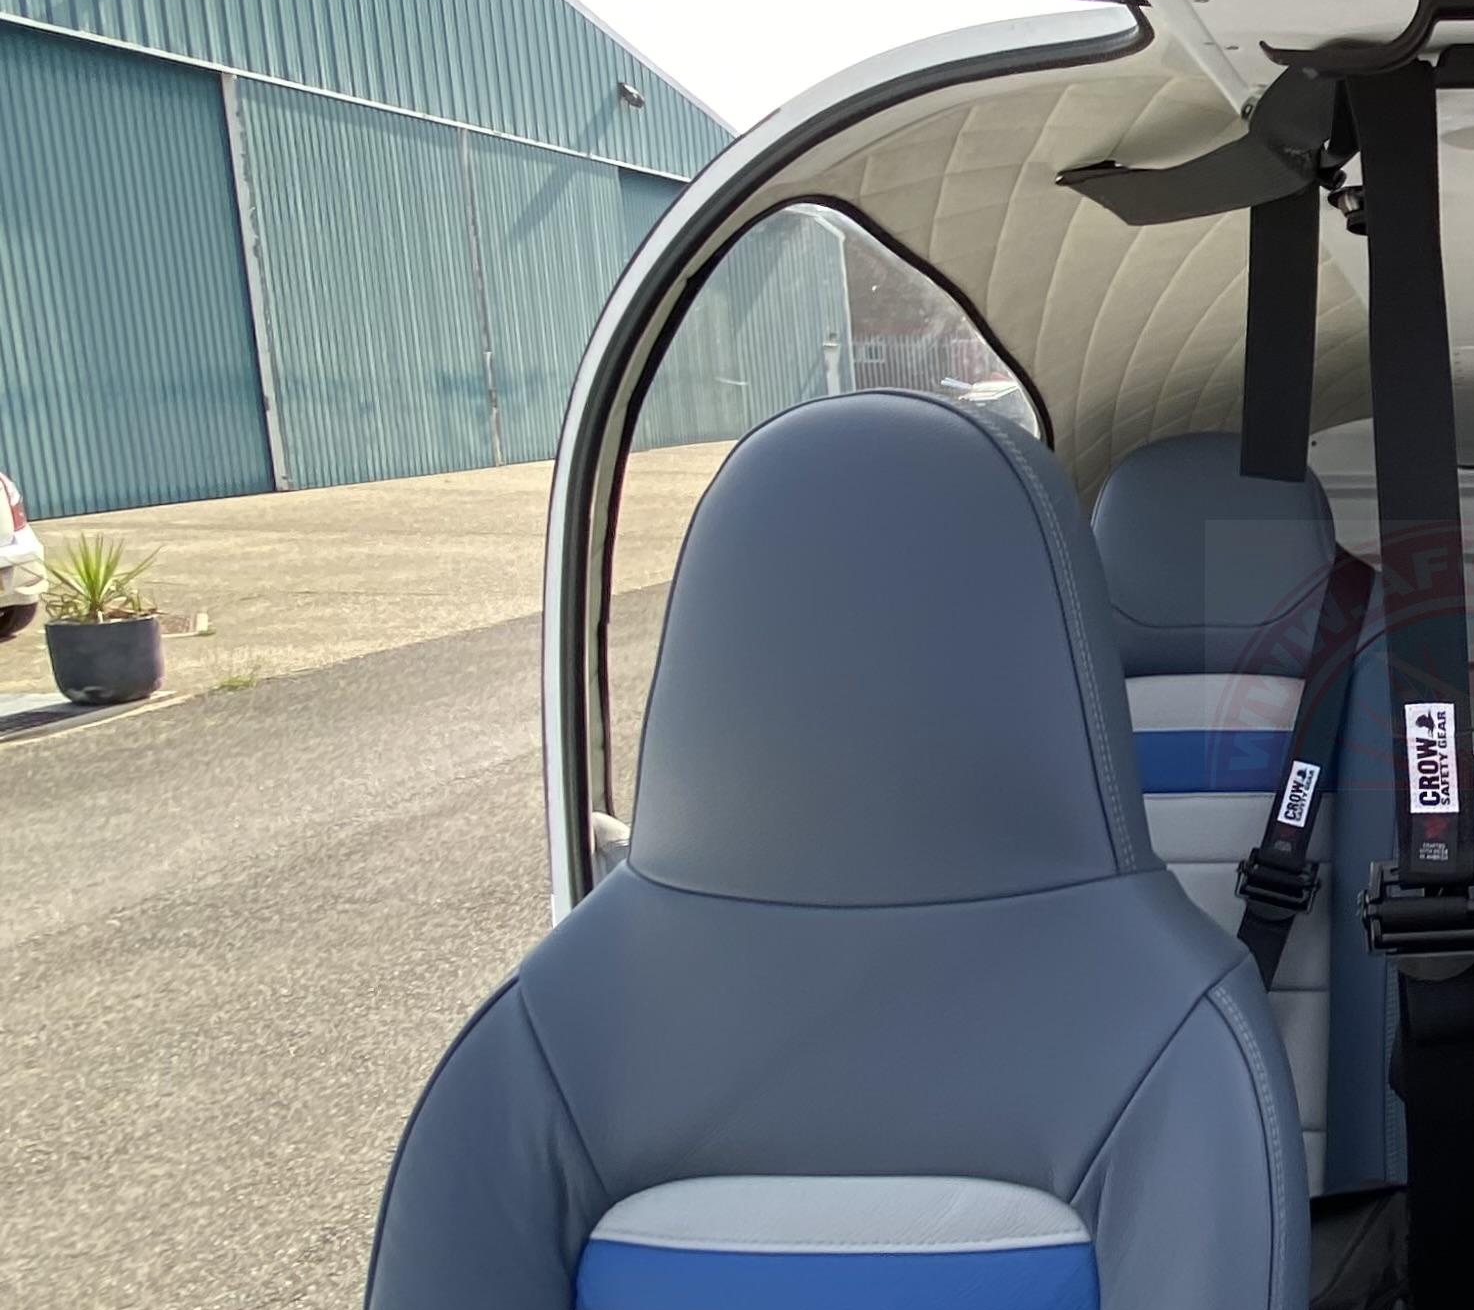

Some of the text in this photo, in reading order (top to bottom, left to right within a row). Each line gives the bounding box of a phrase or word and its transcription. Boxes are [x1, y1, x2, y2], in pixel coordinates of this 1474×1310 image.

[1416, 738, 1440, 806] CROW
[1437, 711, 1451, 805] SAFETY GEAR
[1284, 780, 1303, 820] CROW
